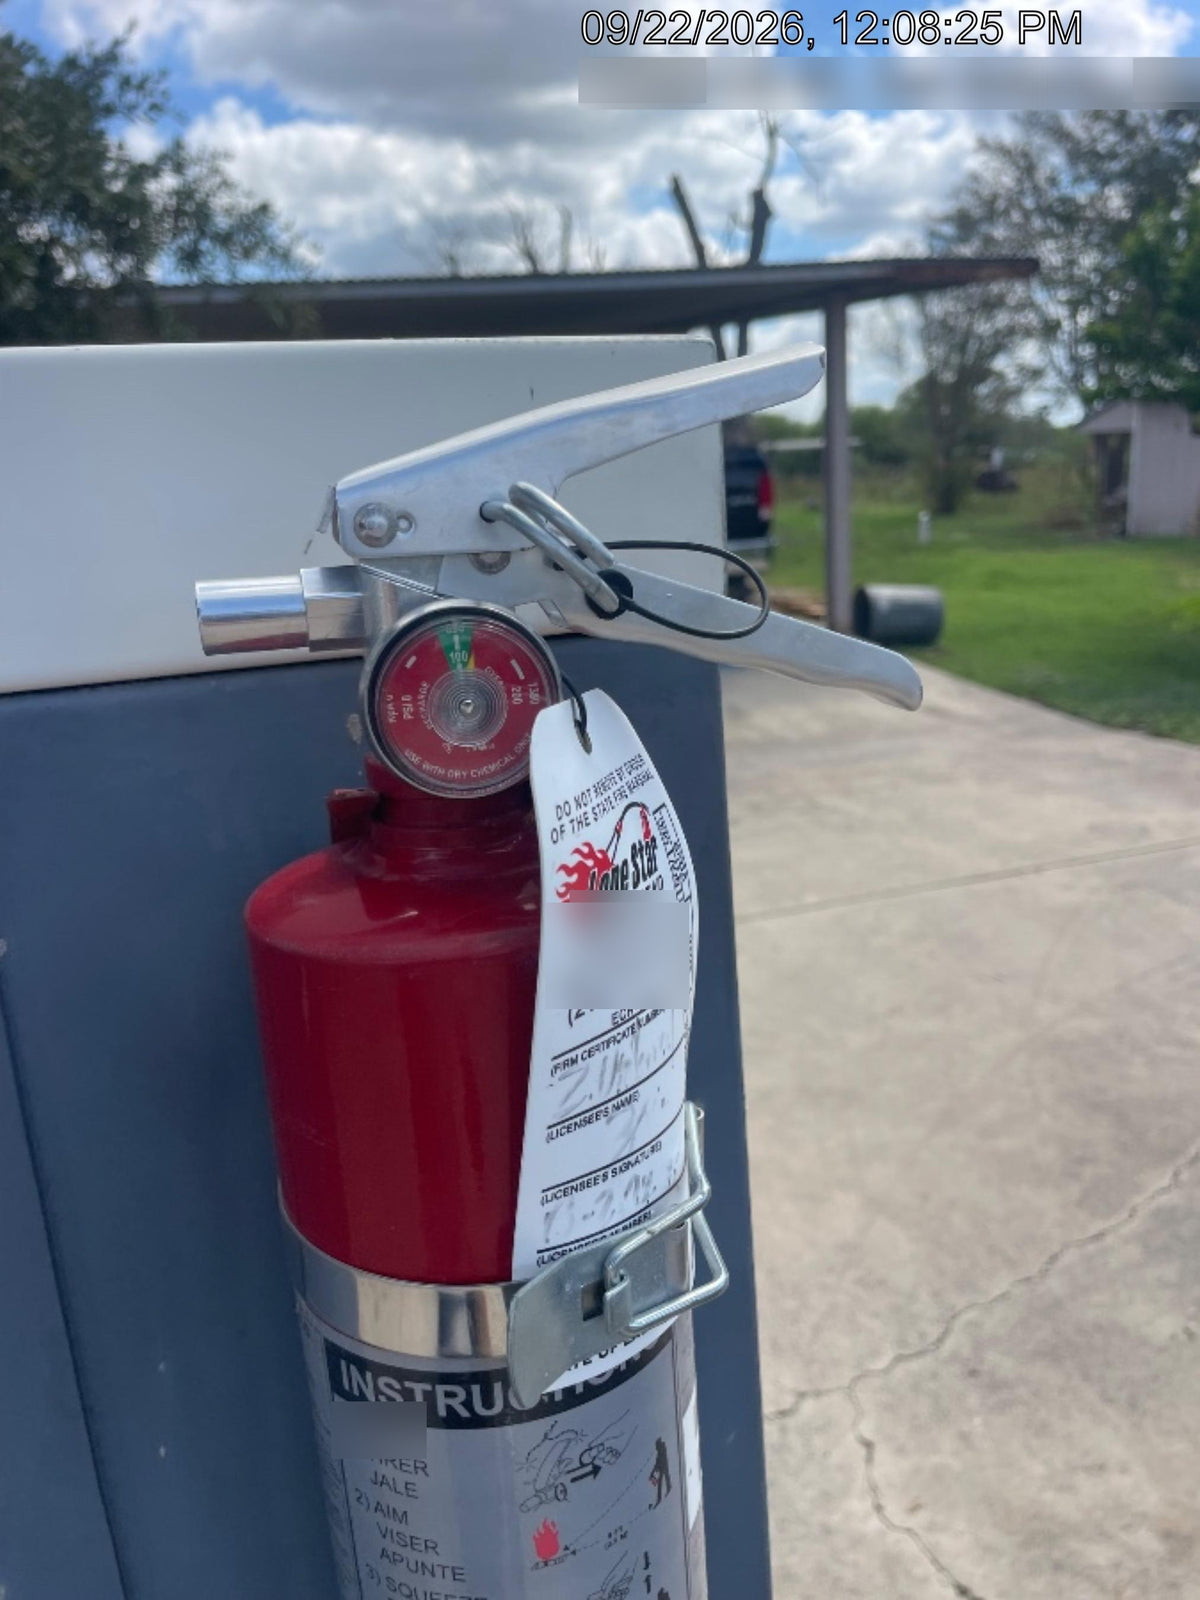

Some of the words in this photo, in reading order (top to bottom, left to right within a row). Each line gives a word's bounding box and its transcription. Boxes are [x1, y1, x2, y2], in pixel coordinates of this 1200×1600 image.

[470, 754, 515, 779] CHEMICAL
[555, 800, 572, 822] DO
[573, 788, 593, 810] NOT
[550, 823, 566, 845] OF
[569, 810, 592, 835] THE
[631, 835, 659, 890] Star
[550, 1053, 579, 1078] (FIRM
[580, 1022, 636, 1062] CERTIFICATE
[370, 1471, 420, 1500] JALE
[355, 1488, 370, 1512] 2)
[374, 1501, 410, 1526] AIM
[376, 1521, 441, 1556] VISER
[379, 1546, 467, 1583] APUNTE
